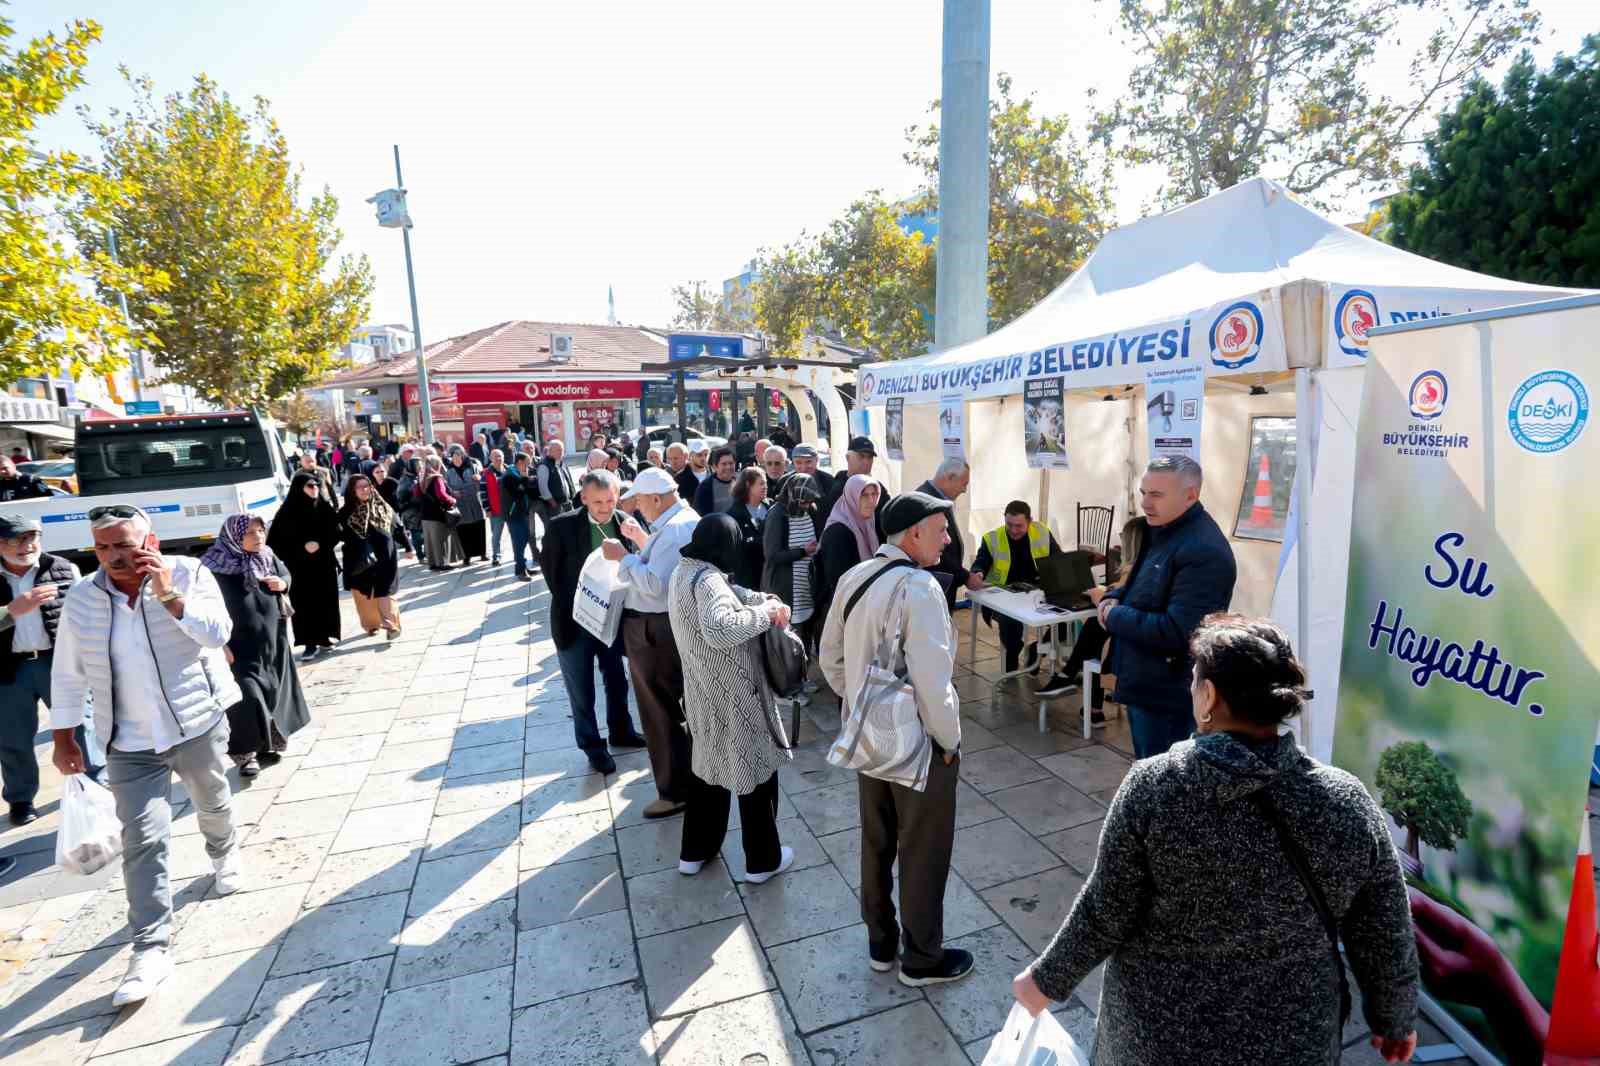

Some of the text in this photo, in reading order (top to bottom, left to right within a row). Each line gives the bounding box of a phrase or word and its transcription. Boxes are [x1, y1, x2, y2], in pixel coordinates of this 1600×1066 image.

[922, 355, 1024, 391] BÜYÜKŞEHİR
[1027, 319, 1191, 377] BELEDİYESİ
[543, 385, 589, 395] vodafone
[1522, 399, 1573, 420] DESKİ
[1408, 424, 1442, 433] DENİZLİ
[1383, 433, 1469, 448] BÜYÜKŞEHİR
[1397, 448, 1448, 457] BELEDİYESİ
[1425, 532, 1494, 597] Su
[1370, 600, 1545, 715] Hayattır.
